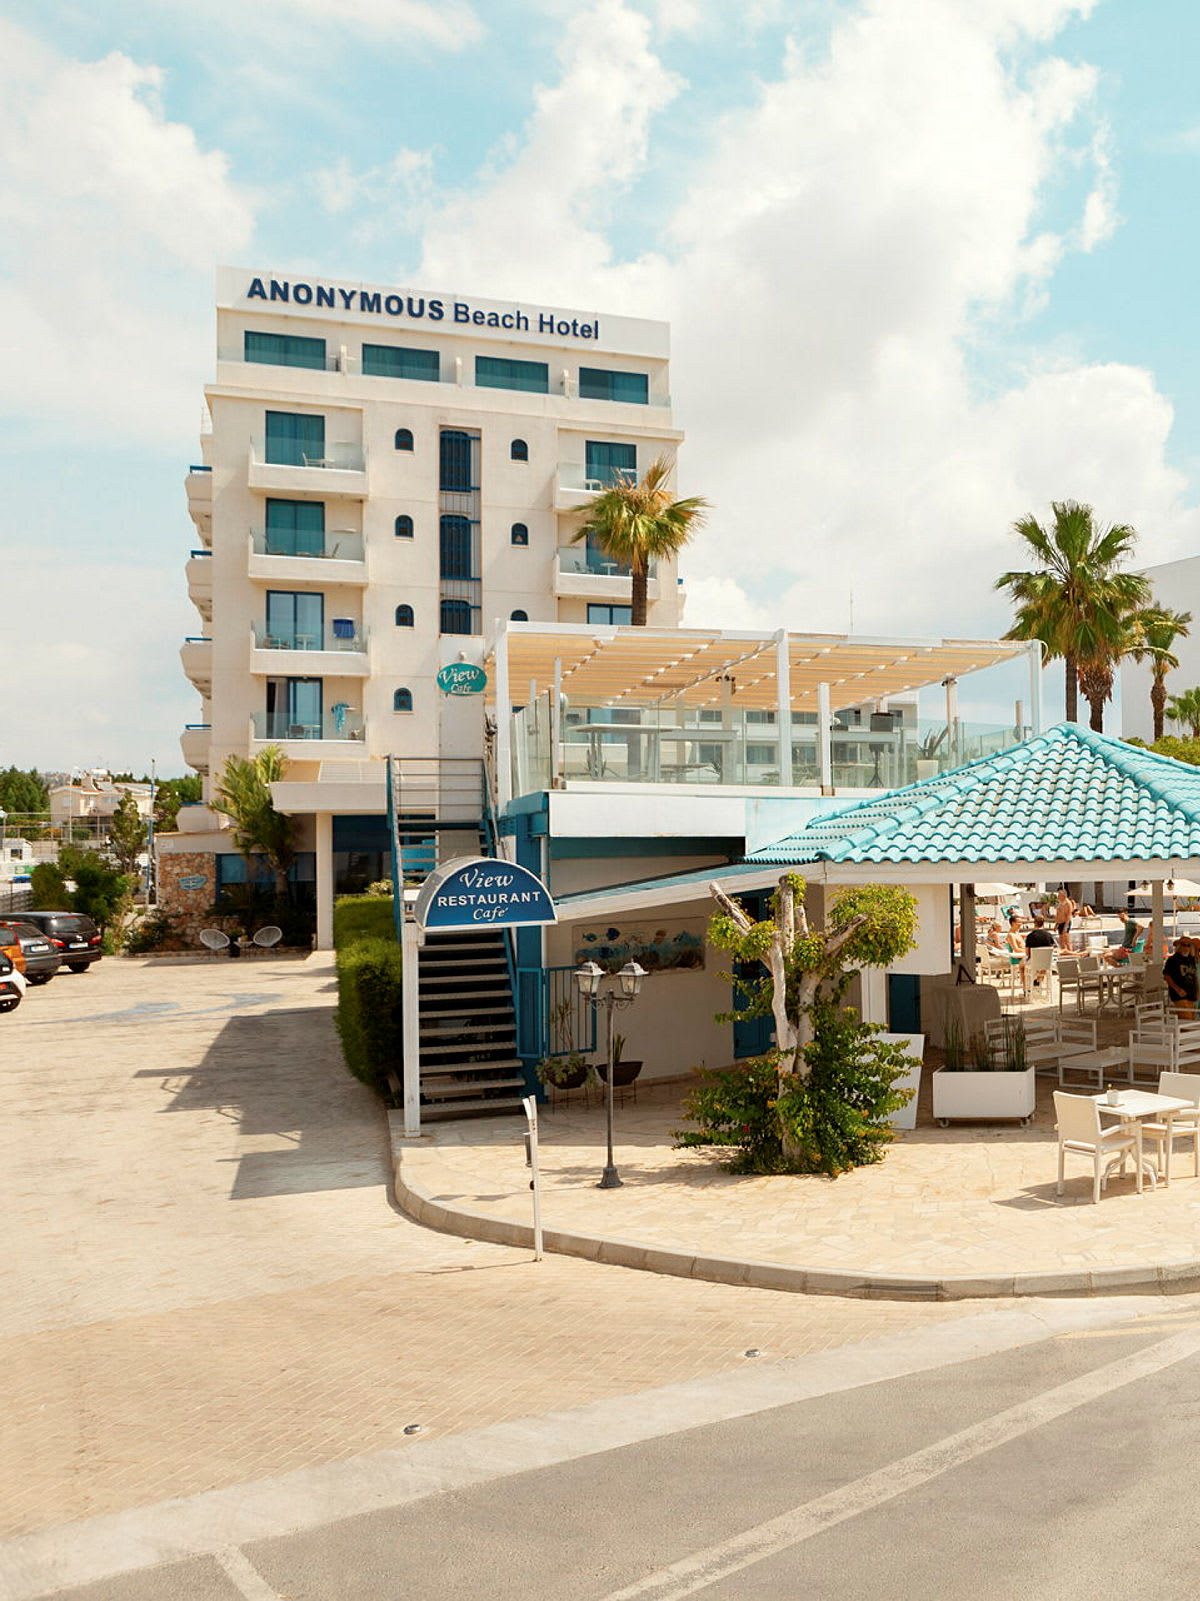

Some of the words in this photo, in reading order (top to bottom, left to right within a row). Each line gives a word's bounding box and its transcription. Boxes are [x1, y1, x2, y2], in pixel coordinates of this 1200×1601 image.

[247, 278, 445, 321] ANONYMOUS
[453, 302, 530, 331] Beach
[538, 313, 599, 340] Hotel
[438, 667, 480, 684] View
[459, 868, 514, 889] View
[437, 891, 541, 907] RESTAURANT
[472, 905, 509, 922] Café
